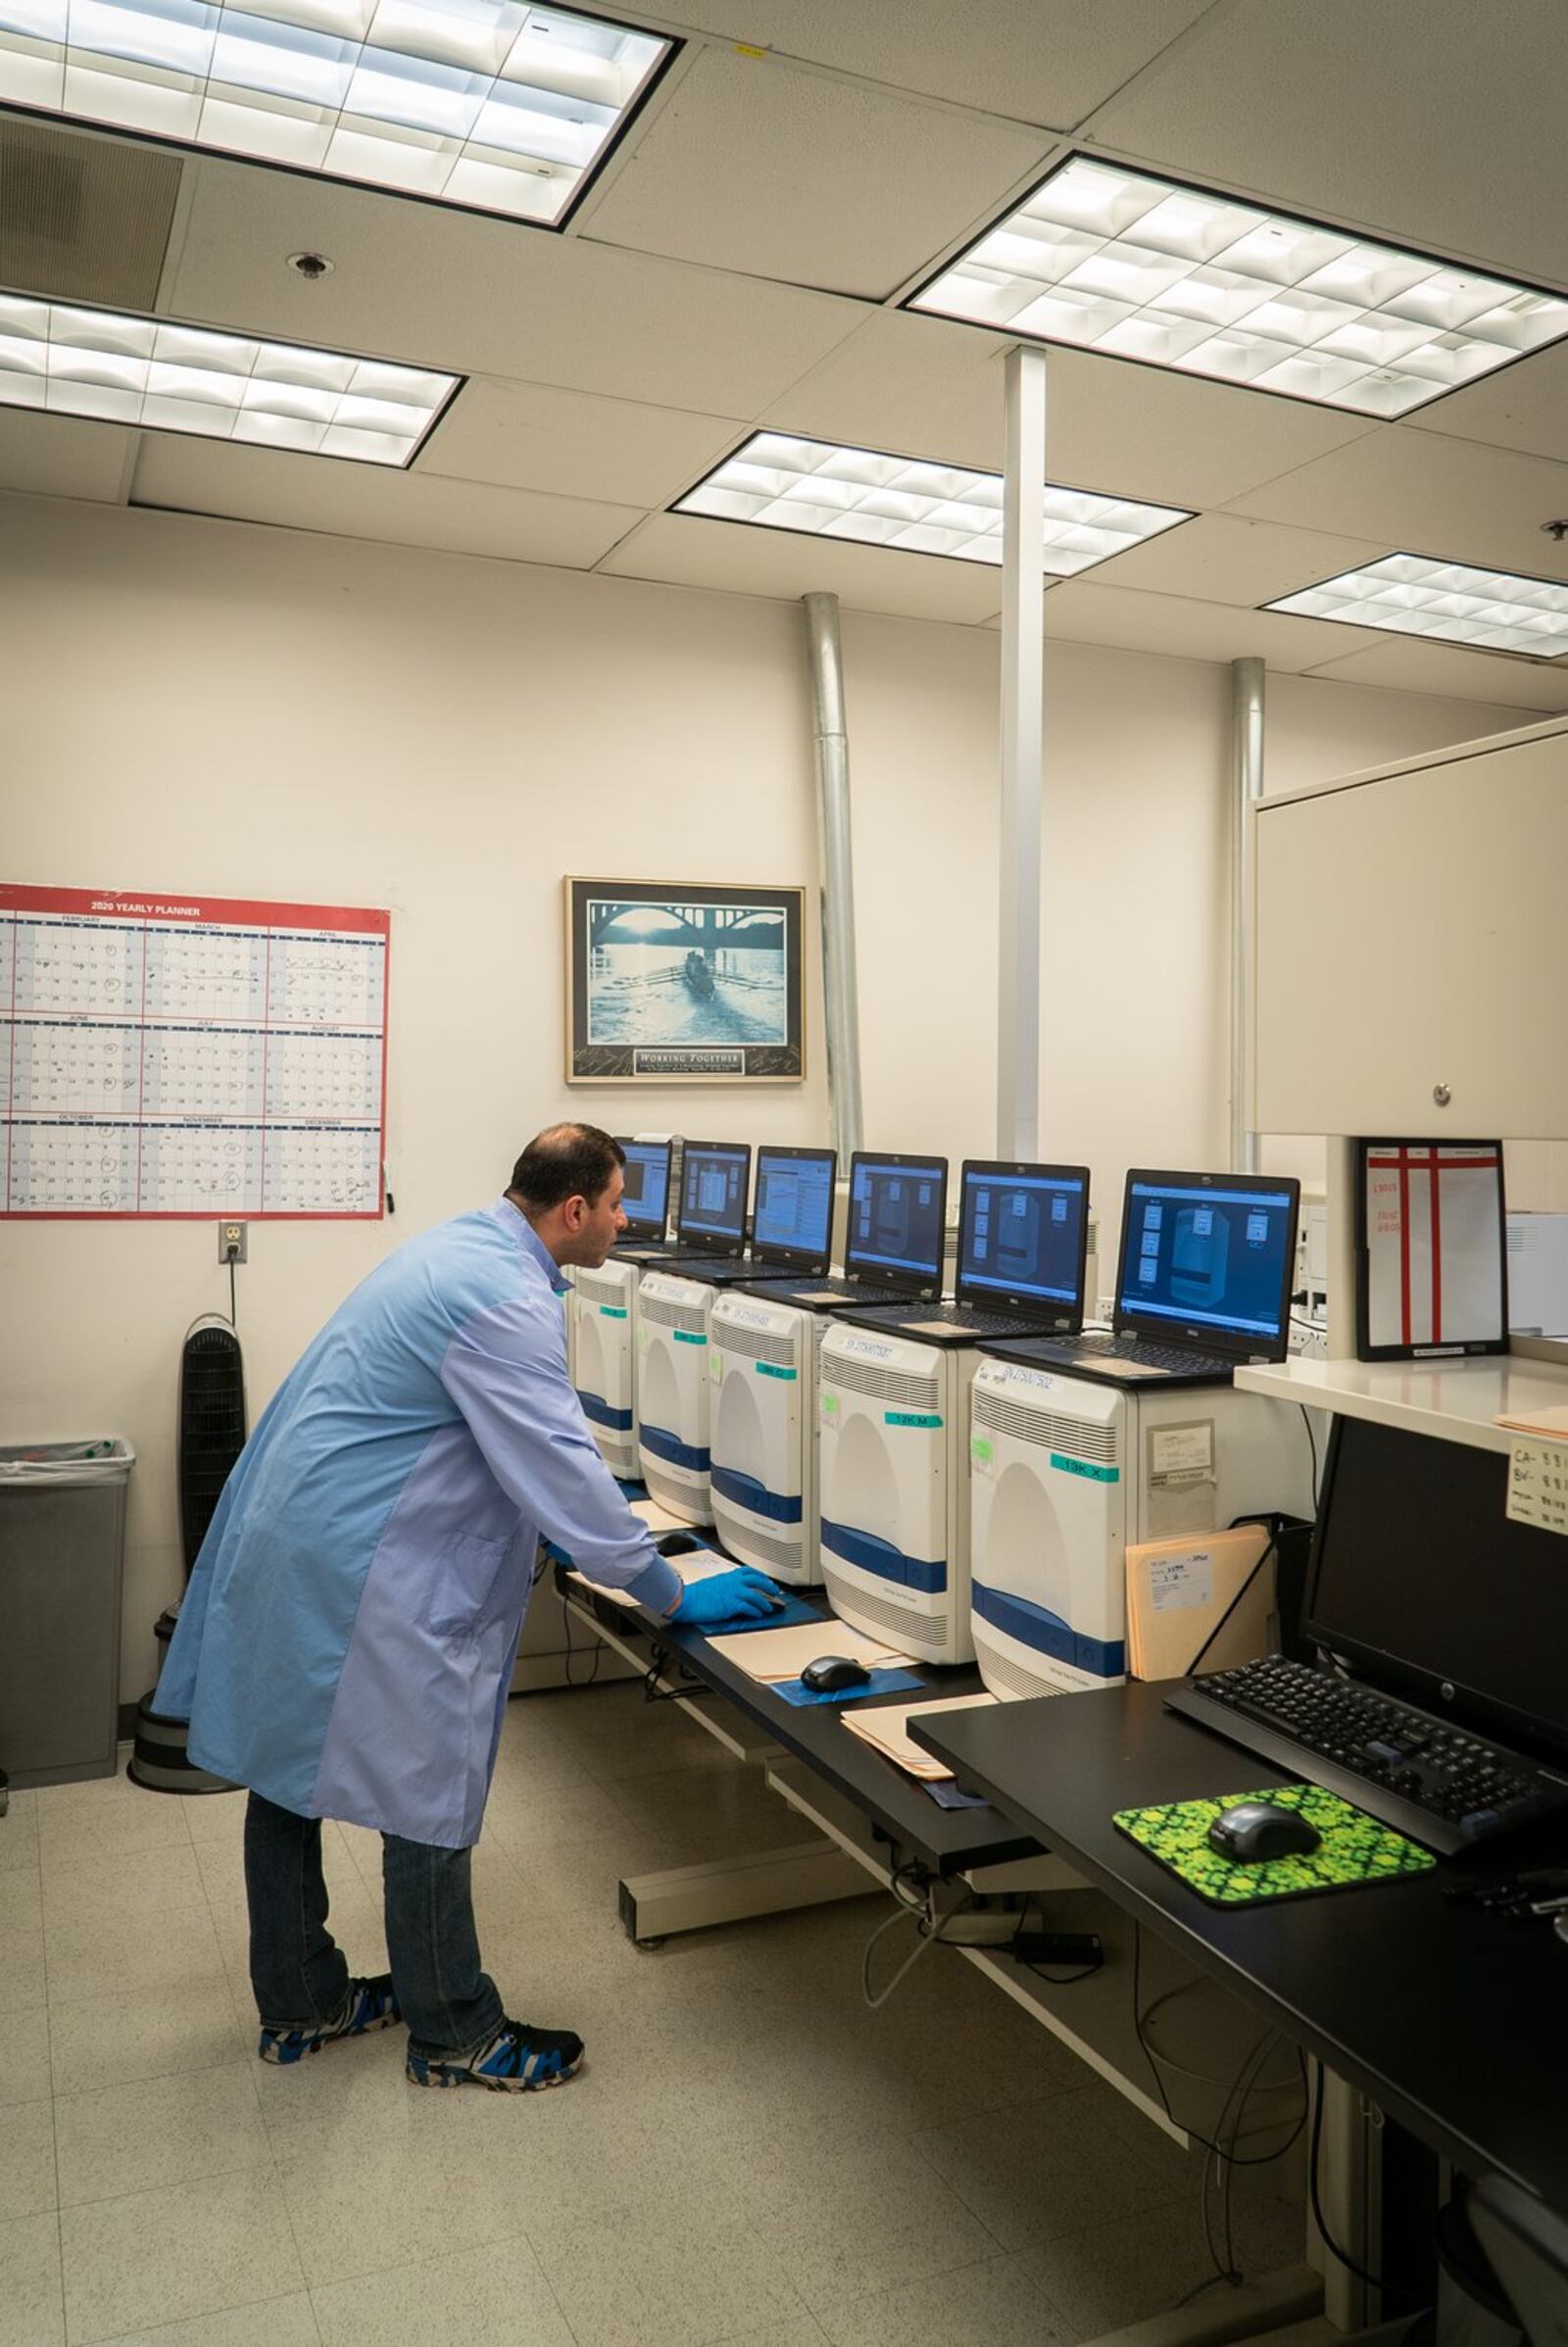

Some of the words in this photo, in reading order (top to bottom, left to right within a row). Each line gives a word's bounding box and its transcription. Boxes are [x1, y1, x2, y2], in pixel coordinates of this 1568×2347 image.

[91, 901, 114, 910] 2020
[116, 903, 154, 913] YEARLY
[155, 905, 201, 916] PLANNER
[641, 1053, 686, 1063] WORKING
[689, 1053, 738, 1063] TOGETHER
